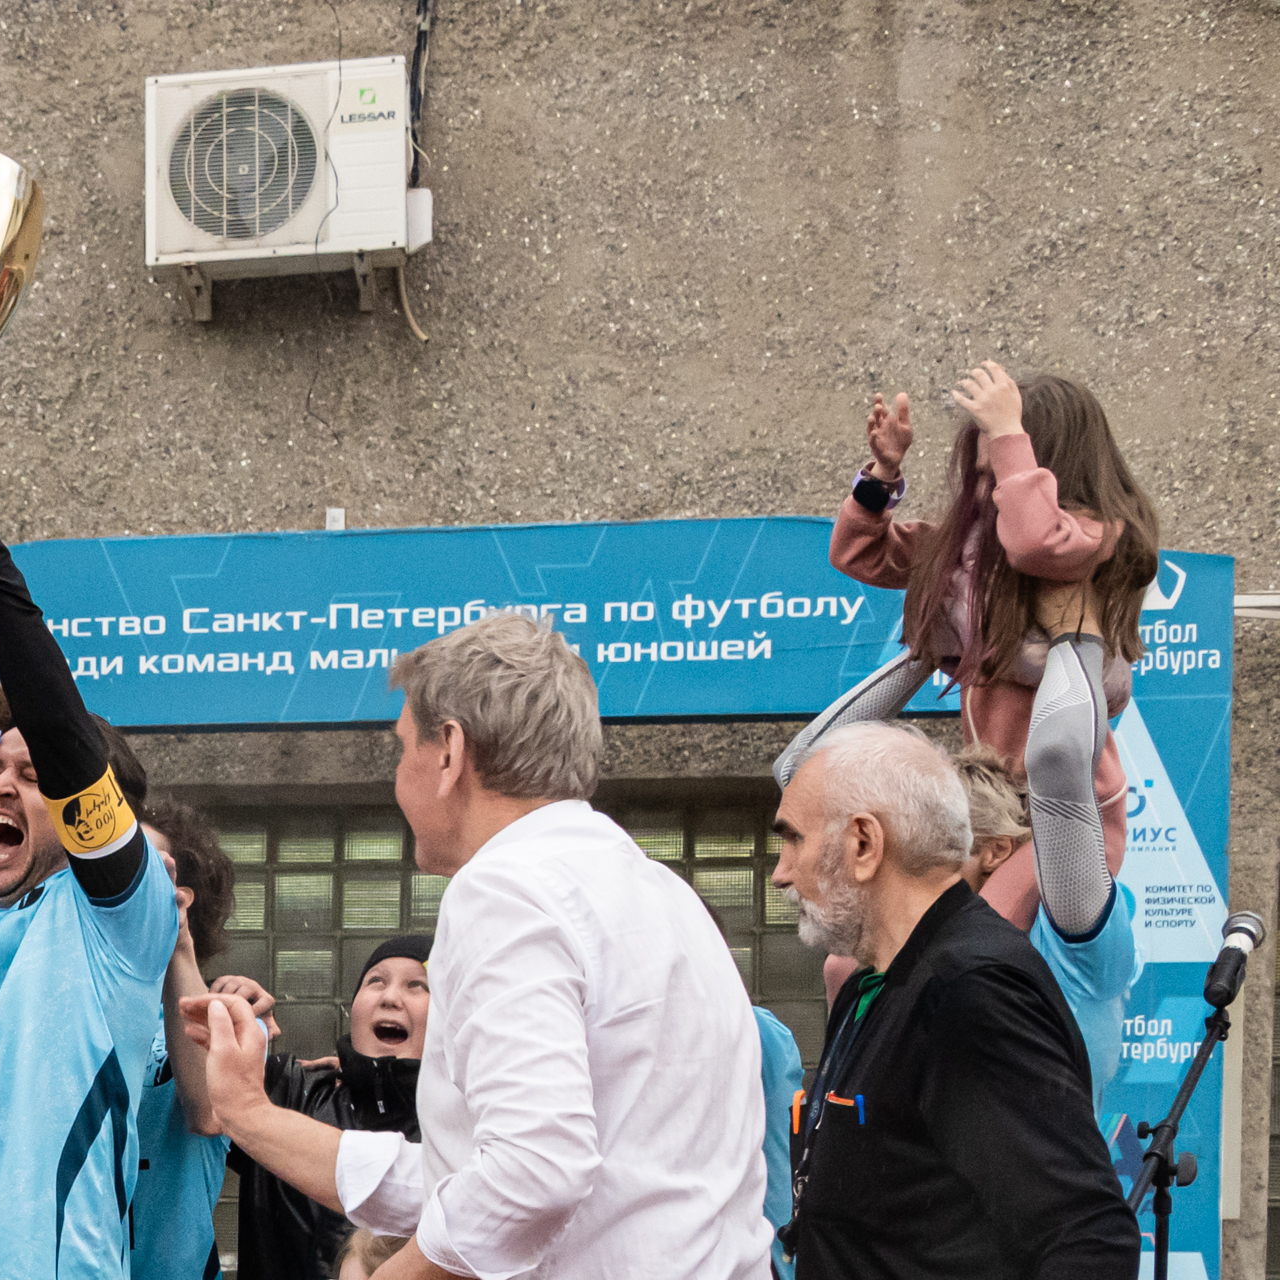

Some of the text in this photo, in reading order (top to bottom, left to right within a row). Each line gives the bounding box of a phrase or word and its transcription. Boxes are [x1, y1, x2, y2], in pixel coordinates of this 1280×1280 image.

[340, 110, 396, 124] LESSAR
[605, 600, 654, 623] по
[671, 592, 864, 629] футболу
[596, 632, 772, 664] юношей
[139, 651, 295, 676] команд
[1127, 827, 1177, 843] ИУС
[1145, 884, 1212, 894] КОМИТЕТ ПО
[1144, 894, 1216, 905] ФИЗИЧЕСКОЙ
[1144, 908, 1193, 917] КУЛЬТУРЕ
[1144, 919, 1197, 928] И СПОРТУ
